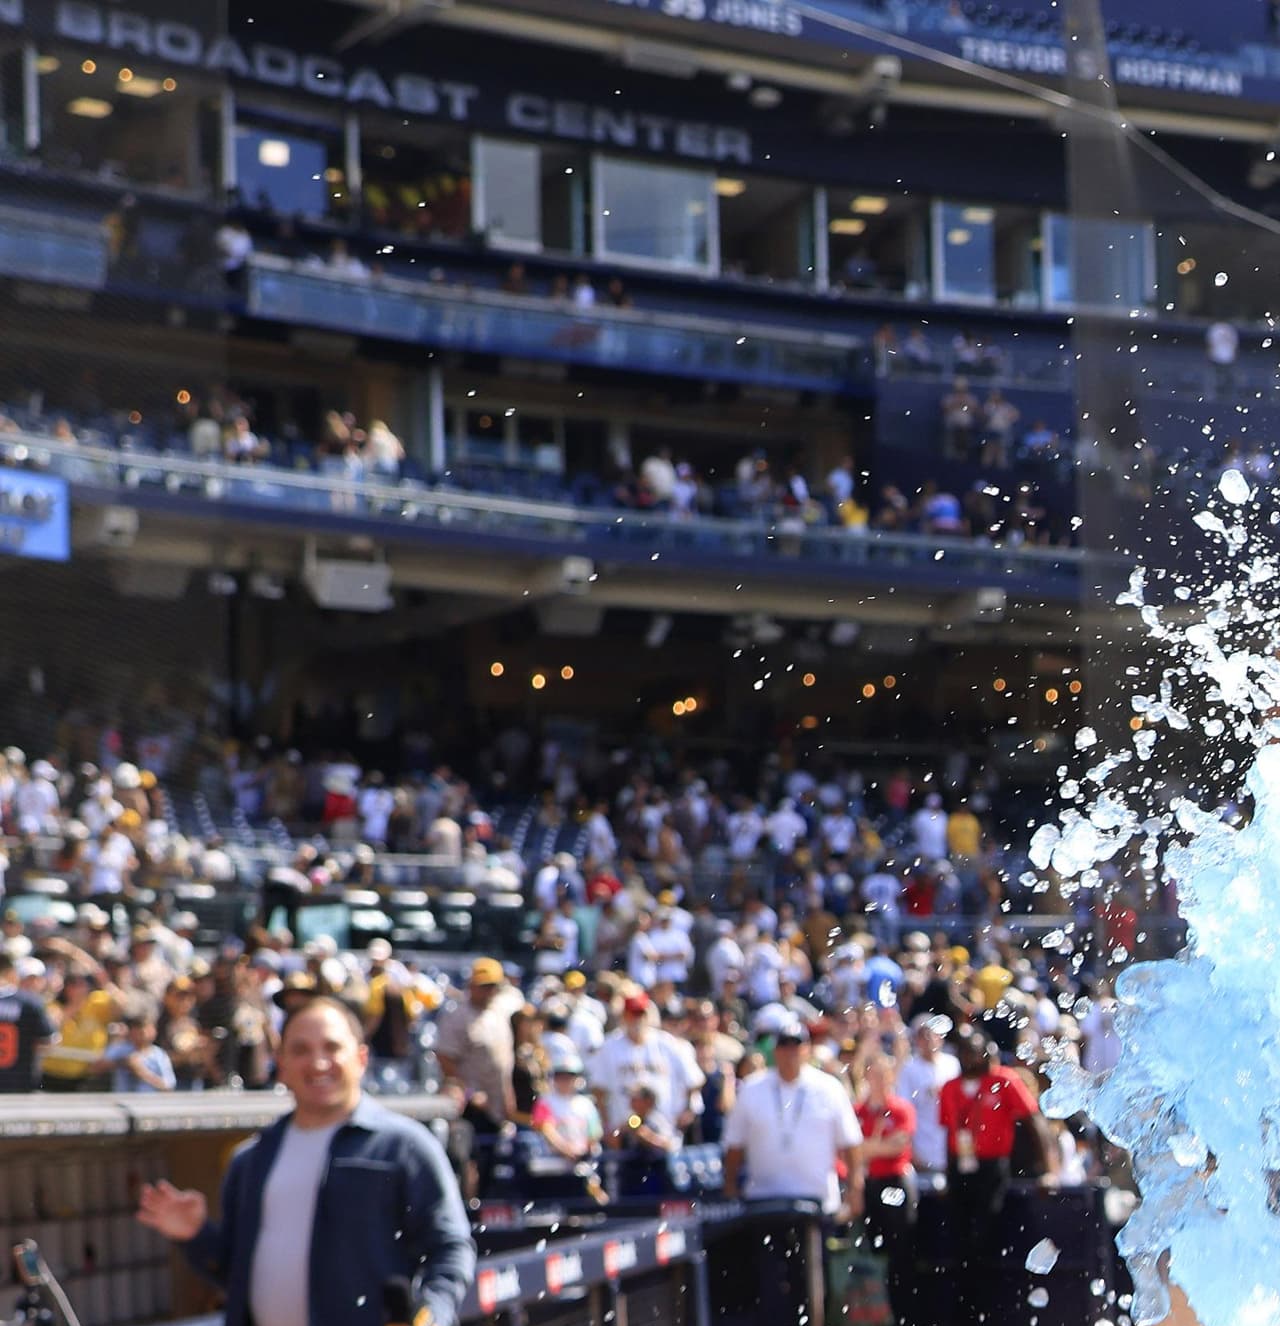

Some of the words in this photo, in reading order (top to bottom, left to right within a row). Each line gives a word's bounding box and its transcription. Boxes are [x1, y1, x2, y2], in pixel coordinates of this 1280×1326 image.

[57, 2, 480, 121] BROADCAST
[505, 92, 752, 164] CENTER
[959, 36, 1067, 74] TREVOR
[1115, 57, 1243, 97] HOFFMAN
